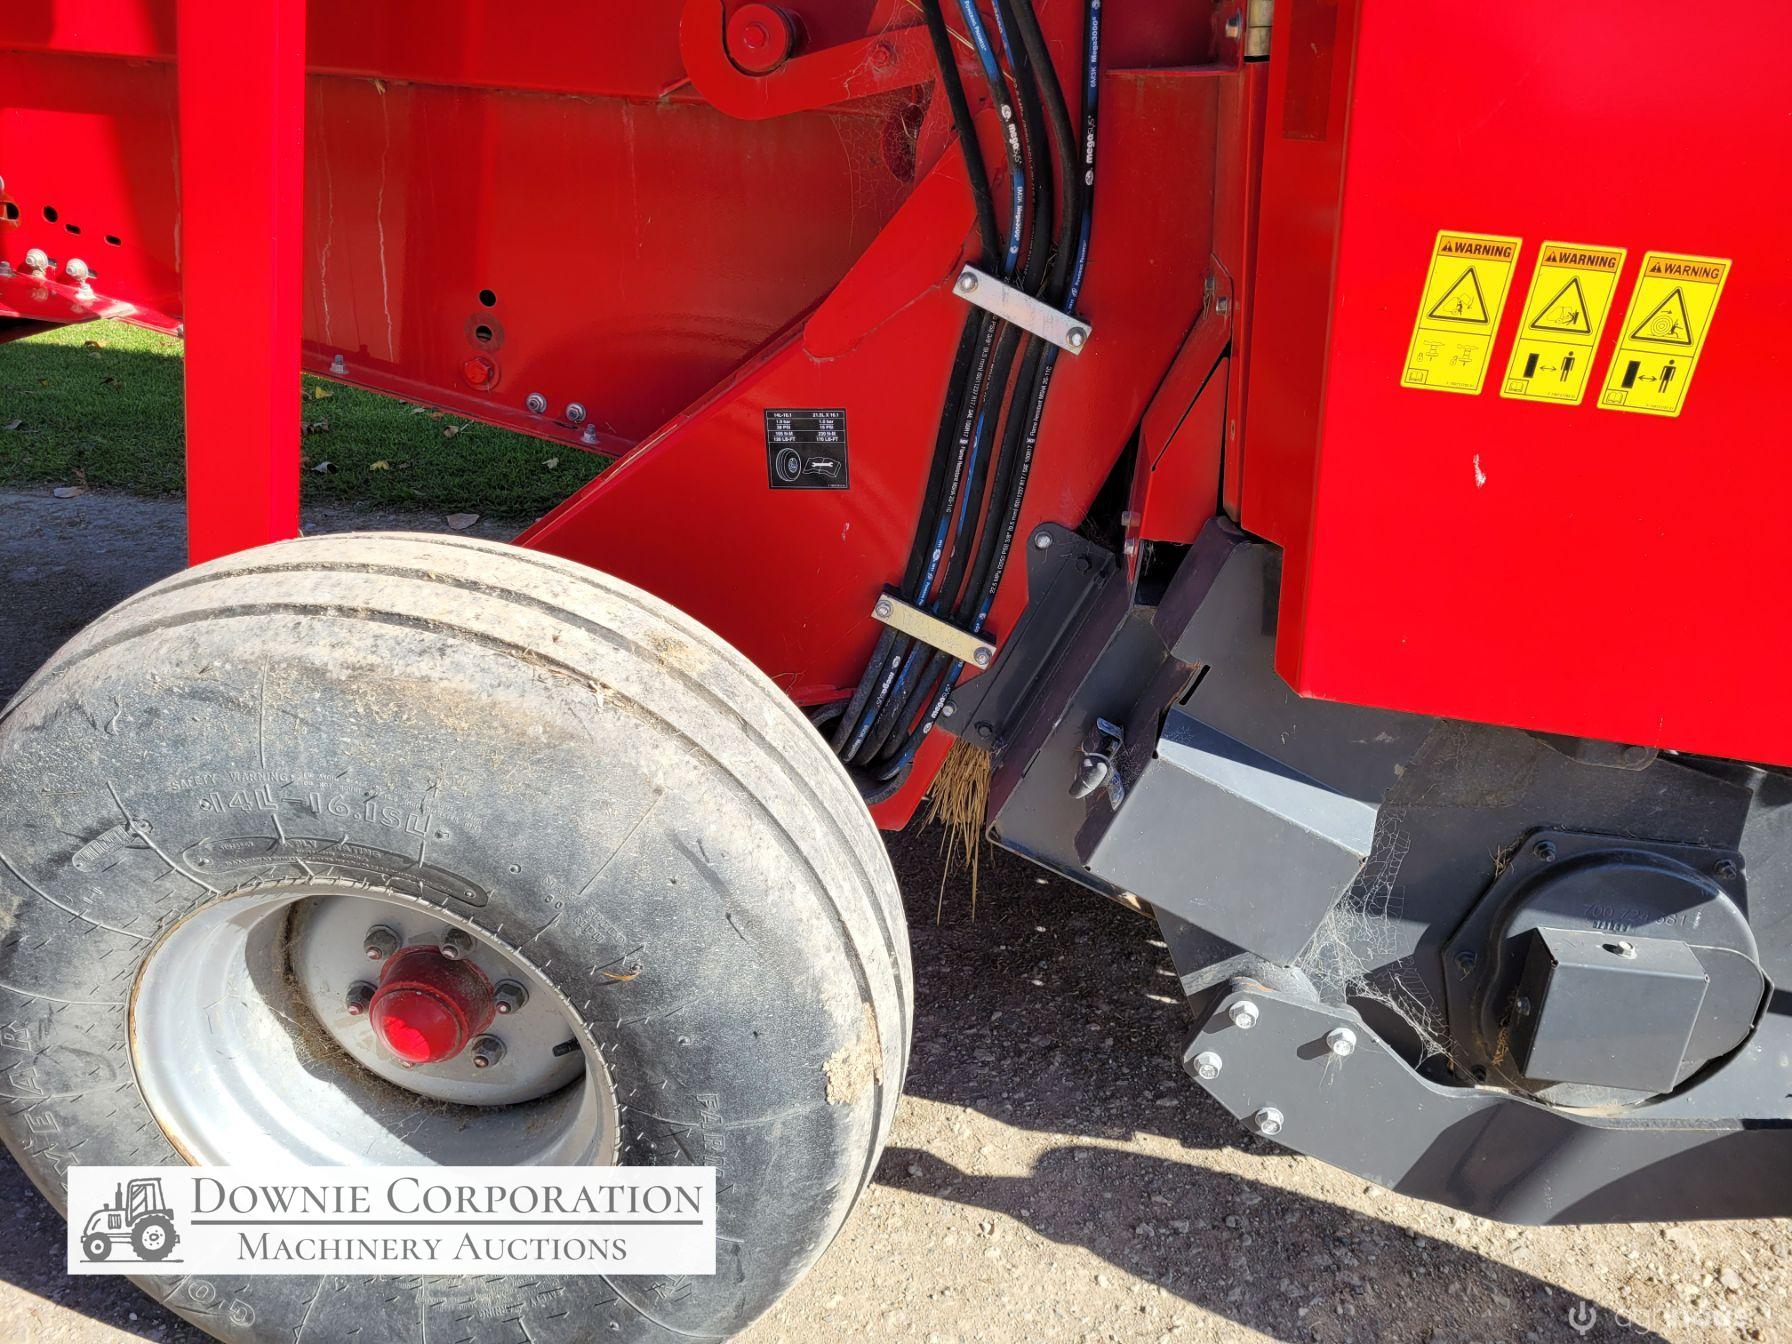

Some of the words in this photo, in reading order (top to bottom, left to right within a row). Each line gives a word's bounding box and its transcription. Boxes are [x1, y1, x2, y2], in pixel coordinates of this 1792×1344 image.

[1454, 241, 1512, 258] WARNING
[1558, 252, 1616, 268] WARNING
[1664, 263, 1719, 279] WARNING
